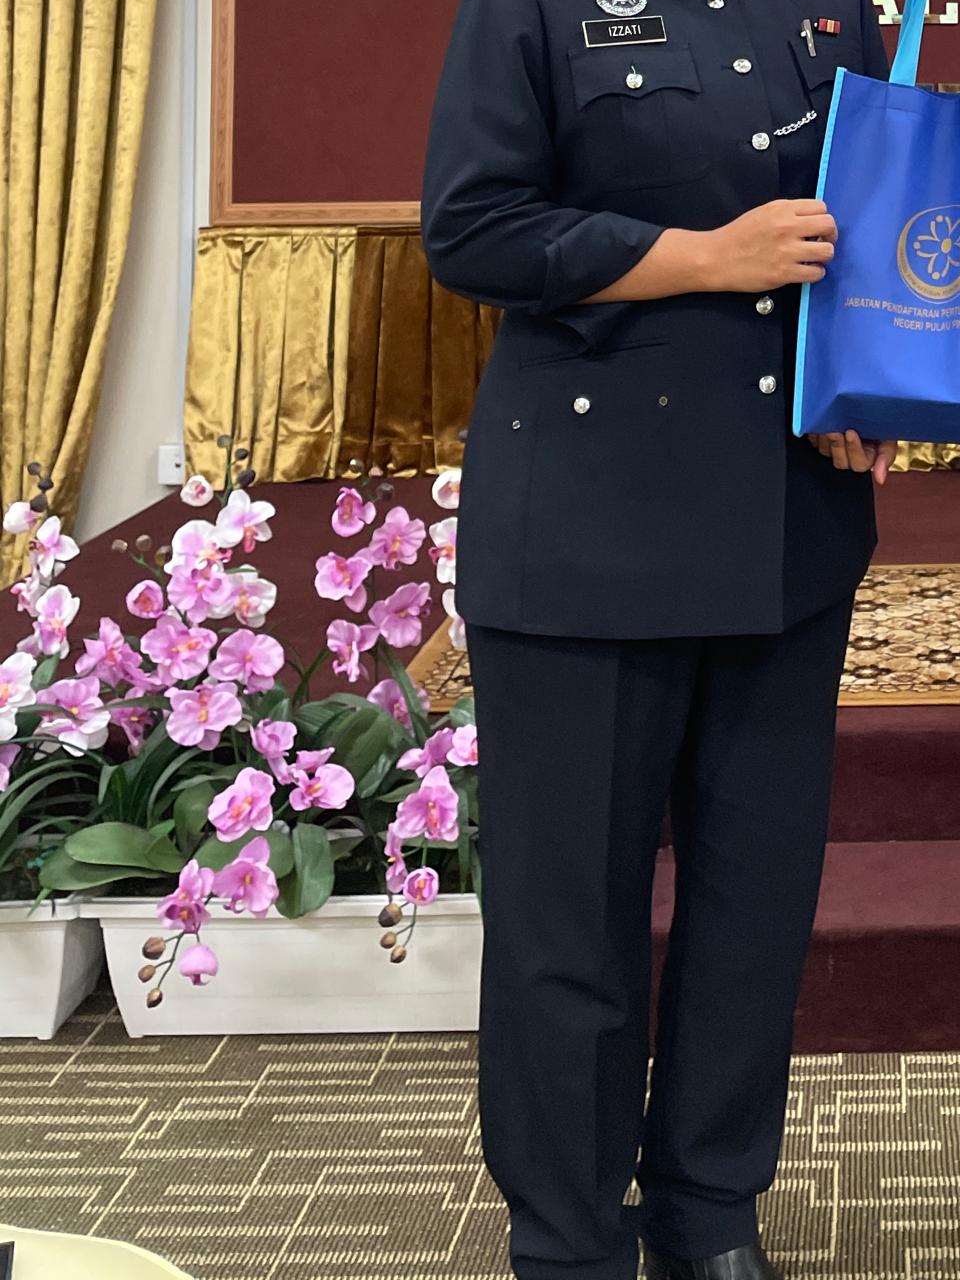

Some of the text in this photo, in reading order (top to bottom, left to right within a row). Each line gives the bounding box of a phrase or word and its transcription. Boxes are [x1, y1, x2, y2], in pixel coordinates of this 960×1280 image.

[608, 24, 642, 37] IZZATI
[844, 297, 881, 309] JABATAN
[881, 301, 940, 318] PENDAFTARAN
[893, 317, 923, 330] NEGERI
[925, 322, 951, 332] PULAU
